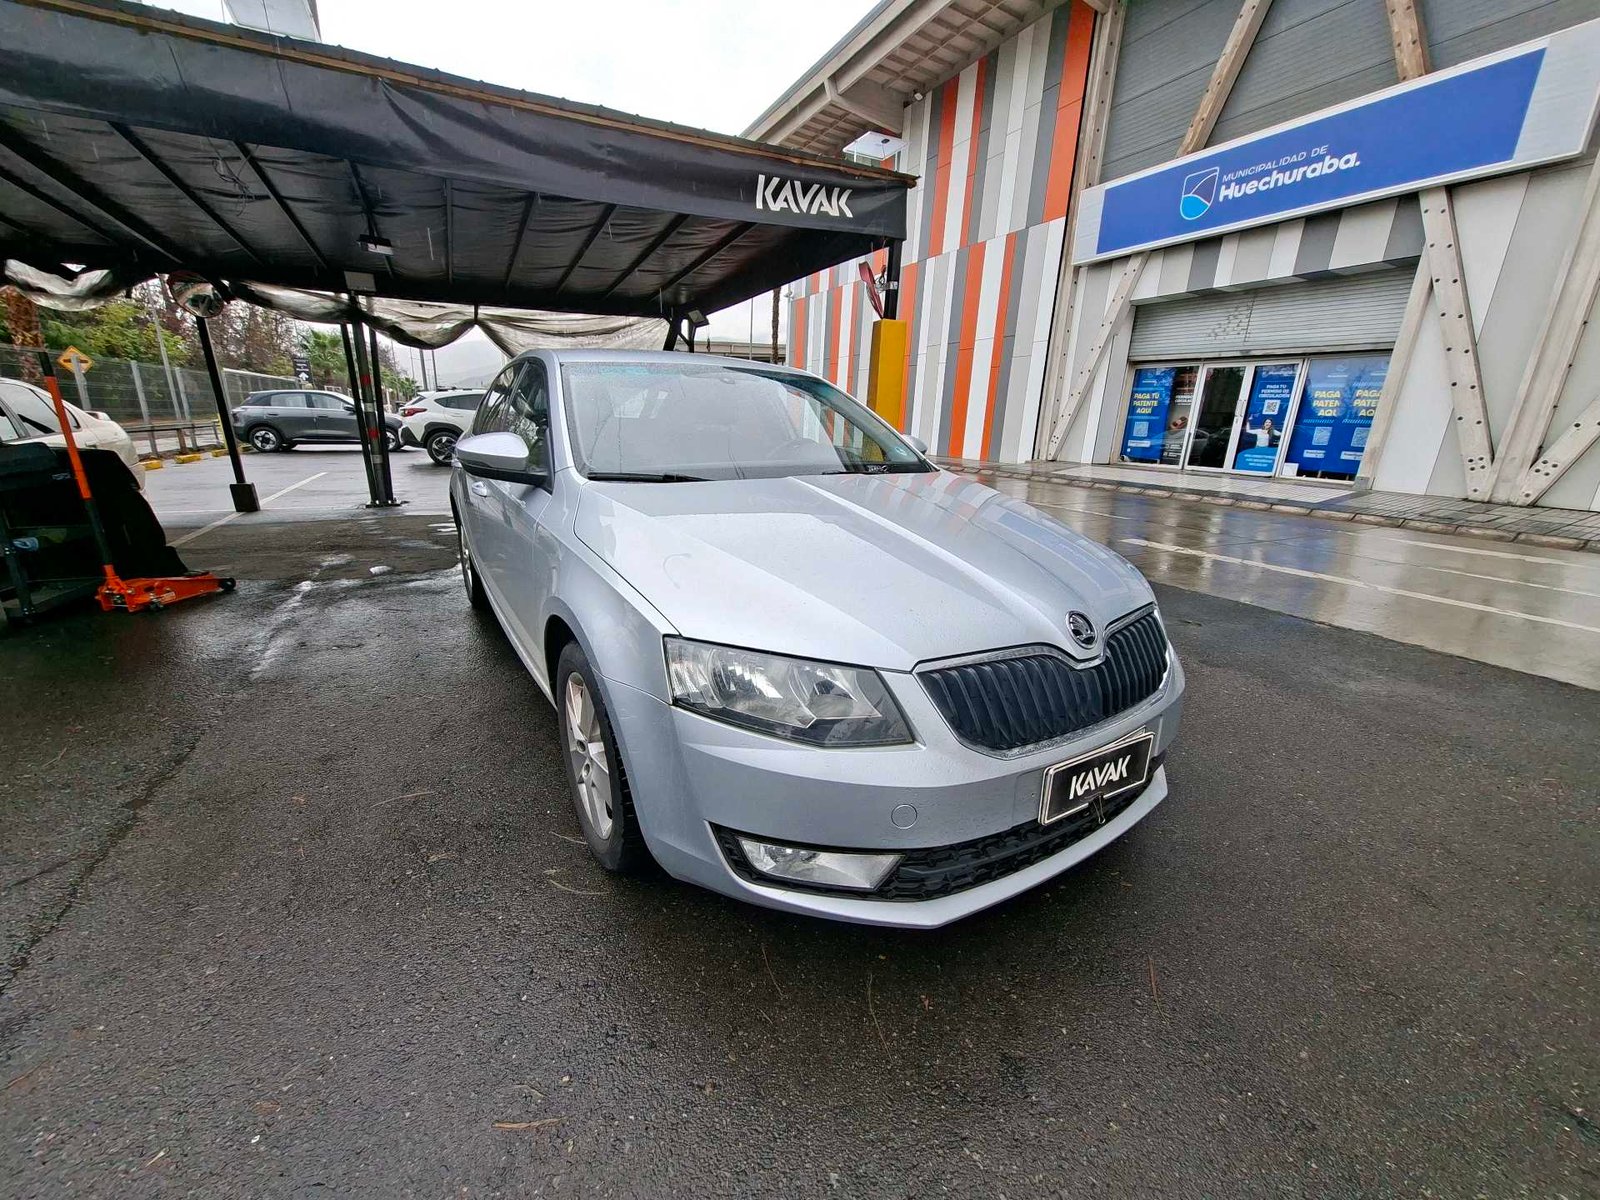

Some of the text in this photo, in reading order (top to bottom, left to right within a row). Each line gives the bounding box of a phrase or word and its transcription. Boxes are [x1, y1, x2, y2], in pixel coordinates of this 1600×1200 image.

[1219, 152, 1361, 202] Huechuraba.
[1222, 144, 1329, 183] MUNICIPALIDAD DE
[756, 174, 853, 218] KAVAK
[1314, 390, 1341, 398] PAGA
[1069, 755, 1131, 800] KAVAK
